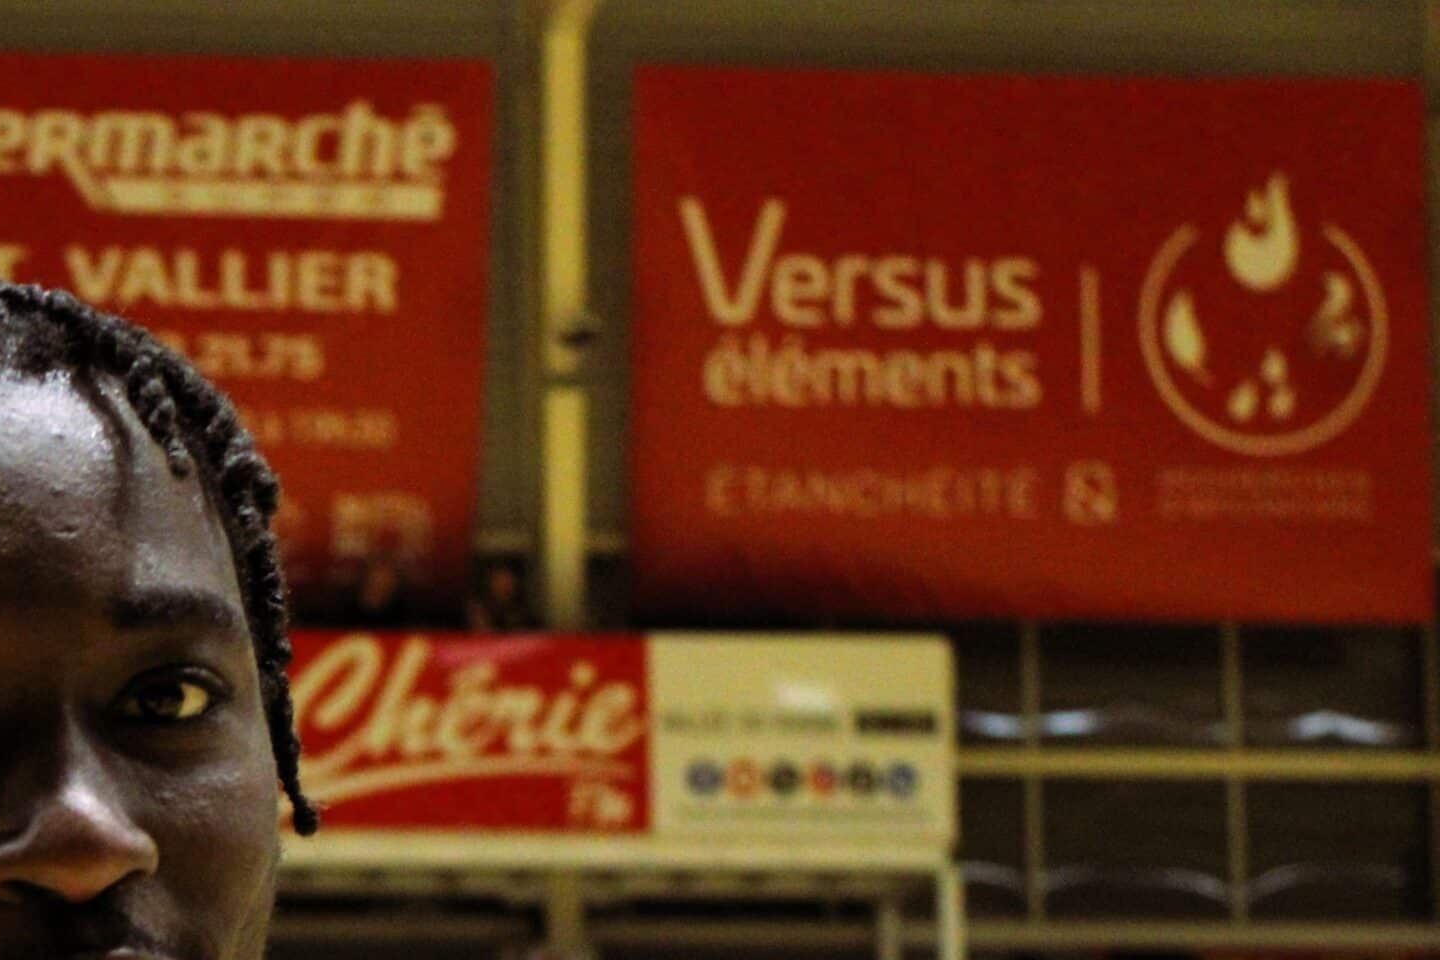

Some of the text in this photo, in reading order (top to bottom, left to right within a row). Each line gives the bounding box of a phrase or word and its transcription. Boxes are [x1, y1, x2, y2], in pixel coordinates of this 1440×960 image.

[64, 244, 398, 311] VALLIER
[678, 196, 1044, 329] Versus
[704, 332, 1043, 409] éléments
[290, 633, 642, 775] Chérie
